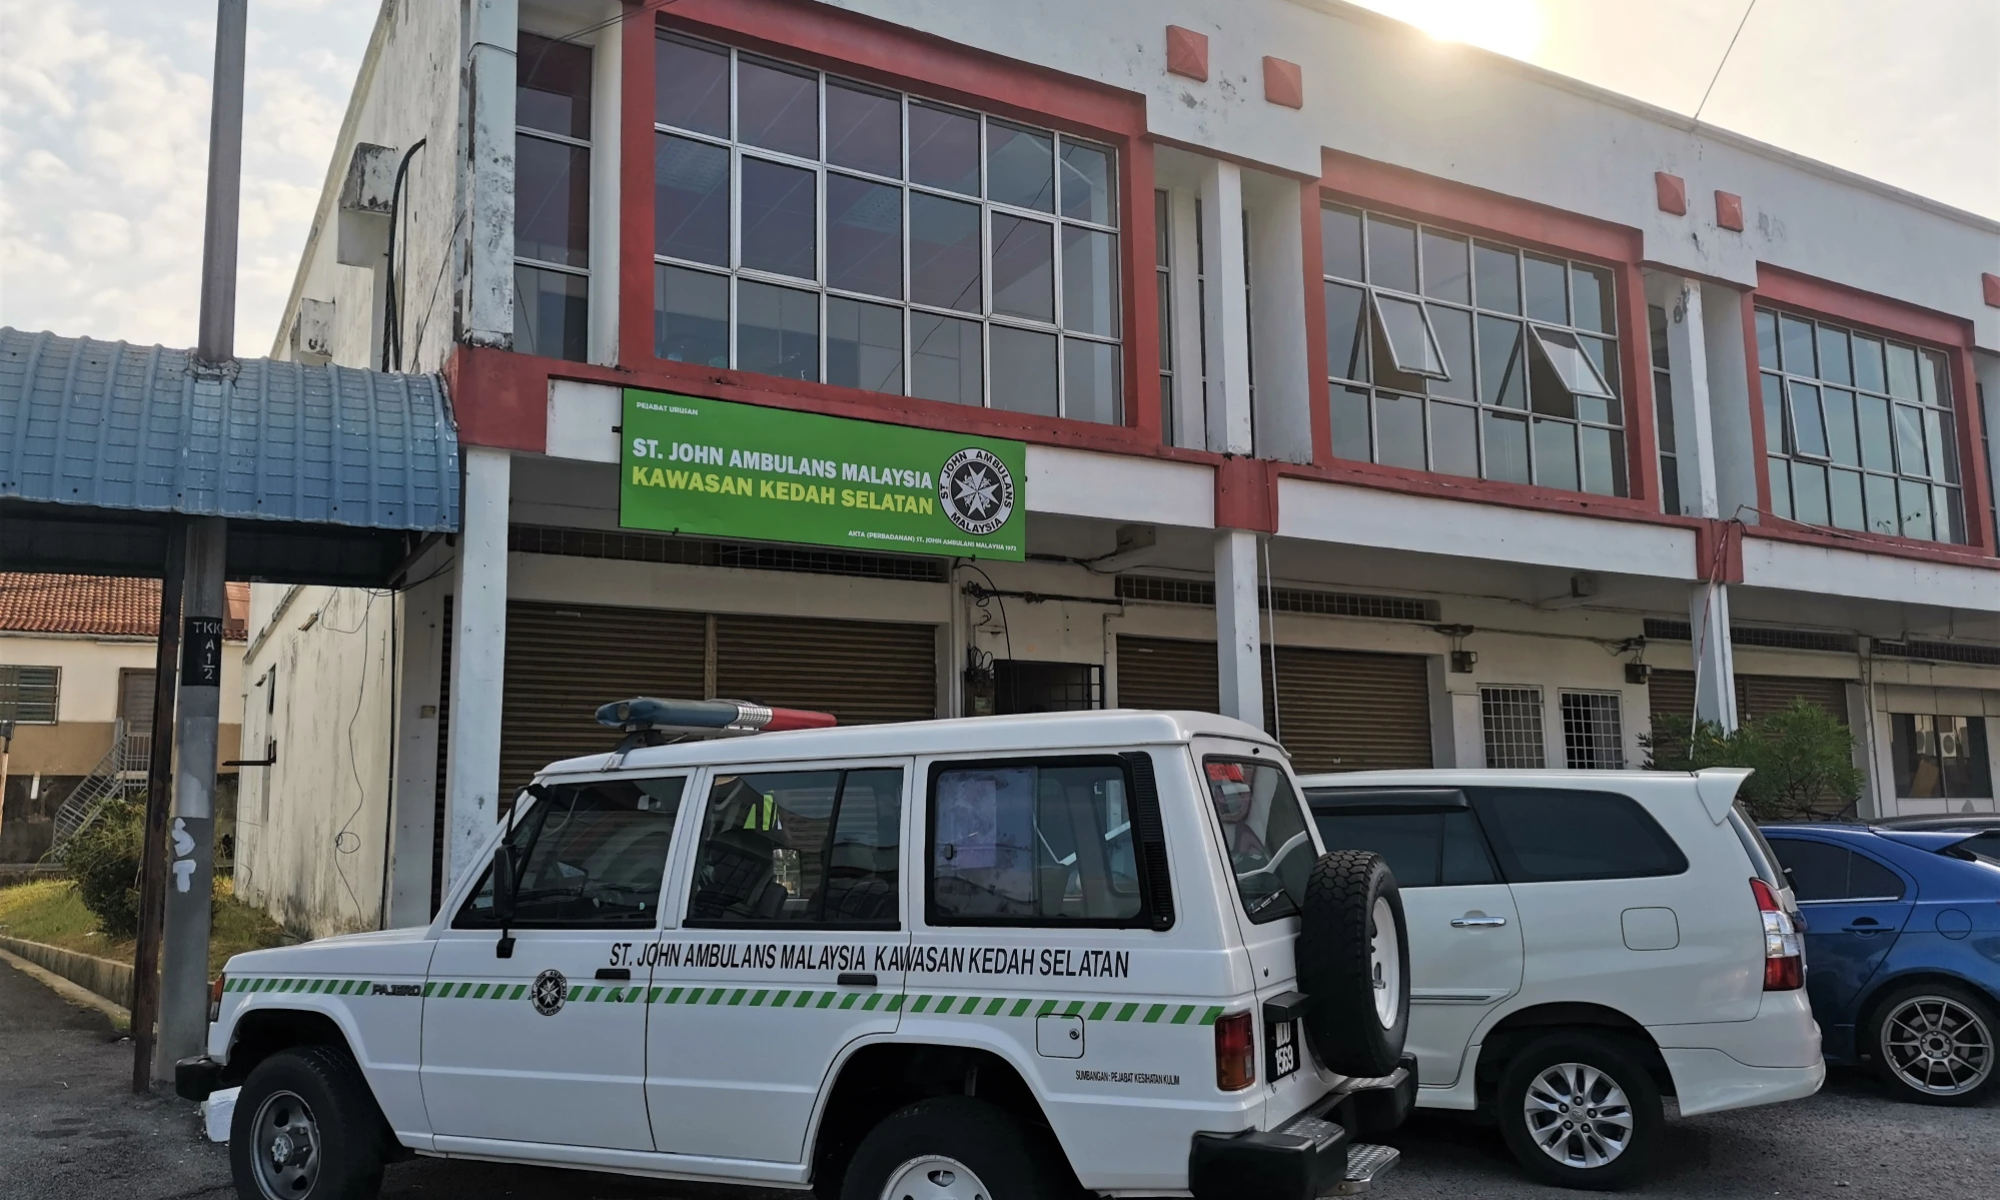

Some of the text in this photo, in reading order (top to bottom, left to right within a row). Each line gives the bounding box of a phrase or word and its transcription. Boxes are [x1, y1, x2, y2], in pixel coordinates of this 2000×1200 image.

[636, 401, 699, 416] PEJABAT URUSAN
[632, 437, 933, 490] ST. JOHN AMBULANS MALAYSIA
[632, 466, 933, 516] KAWASAN KEDAH SELATAN
[944, 451, 968, 479] JOHN
[975, 450, 1014, 509] AMBULANS
[950, 512, 1003, 534] MALAYSIA
[848, 530, 866, 538] AKTA
[925, 537, 942, 545] JOHN
[942, 539, 975, 548] AMBULANS
[975, 542, 1005, 551] MALAYSIA
[205, 638, 215, 650] A
[609, 943, 1130, 978] ST. JOHN AMBULANS MALAYSIA KAWASAN KEDAH SELATAN
[371, 984, 421, 997] PAJERO
[1275, 1044, 1294, 1077] 1569
